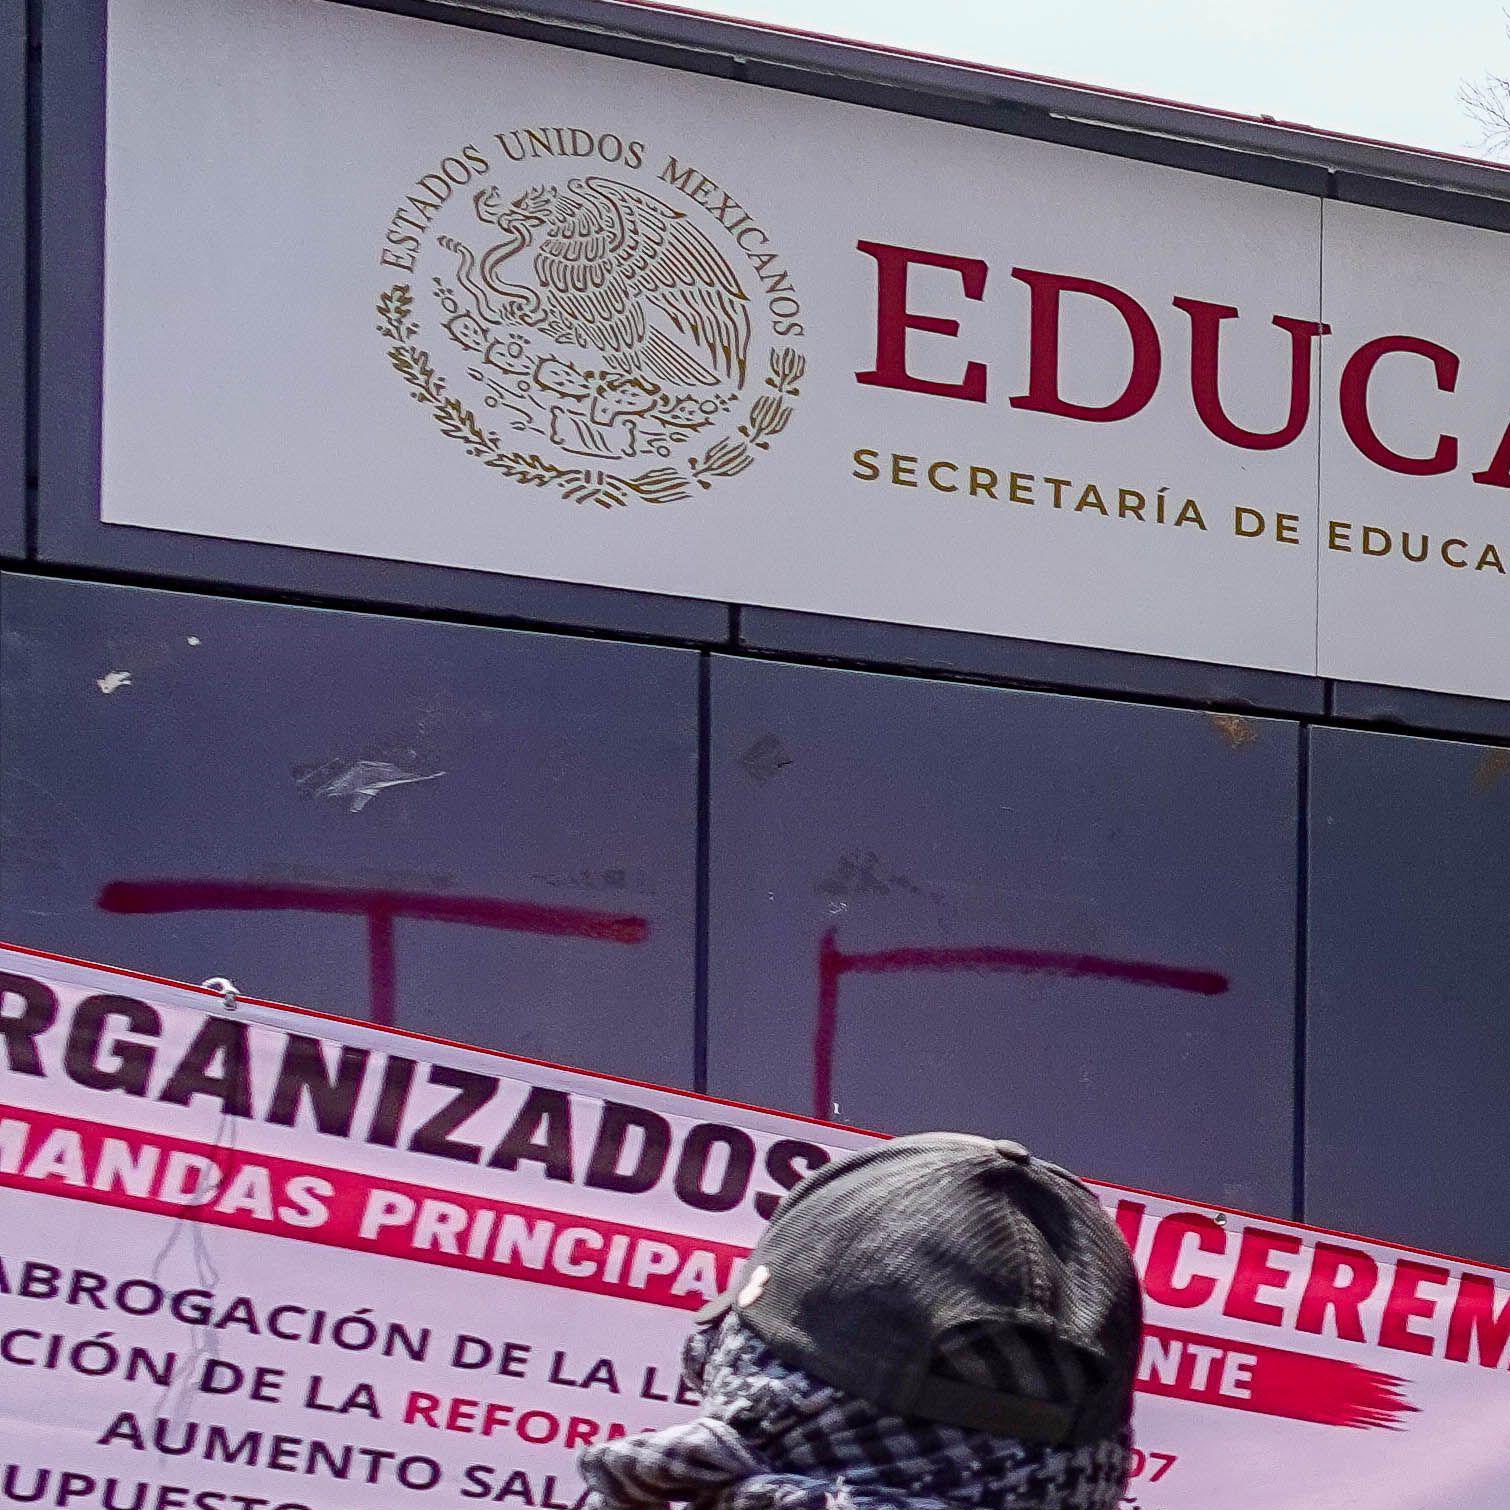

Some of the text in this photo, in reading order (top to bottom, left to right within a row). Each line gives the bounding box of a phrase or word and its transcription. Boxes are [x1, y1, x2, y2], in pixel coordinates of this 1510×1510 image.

[379, 127, 804, 338] ESTADOS UNIDOS MEXICANOS
[852, 448, 1208, 531] SECRETARÍA
[1233, 506, 1301, 544] DE
[199, 1358, 287, 1403] DE
[304, 1375, 382, 1419] LA
[450, 1334, 532, 1378] DE
[548, 1350, 620, 1394] LA
[96, 1411, 442, 1491] AUMENTO
